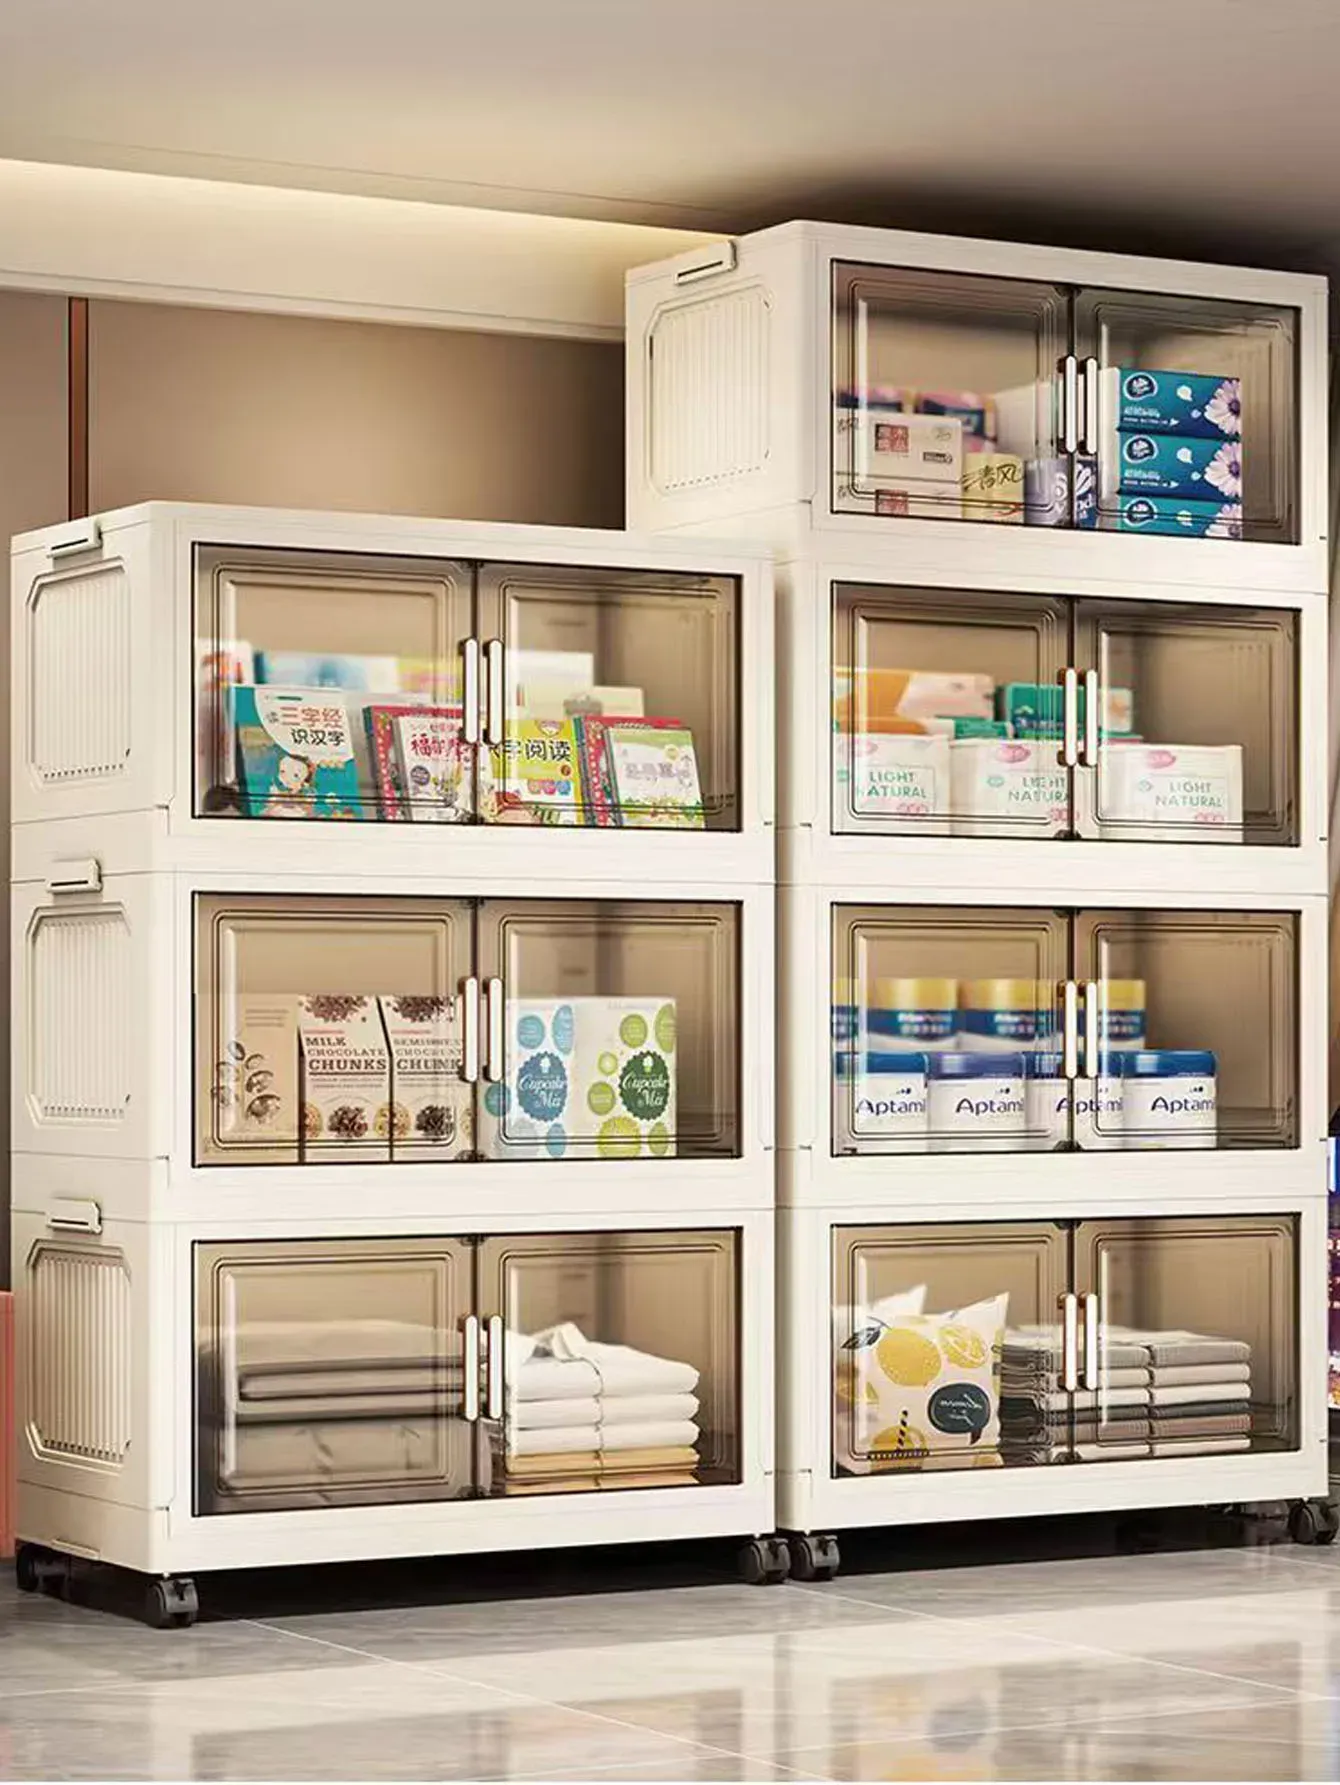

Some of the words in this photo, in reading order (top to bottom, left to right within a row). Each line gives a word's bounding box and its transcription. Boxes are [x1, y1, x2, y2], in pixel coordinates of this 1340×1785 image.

[280, 705, 343, 728] 三字经
[291, 728, 345, 747] 识汉字
[869, 771, 914, 783] LIGHT
[1170, 781, 1212, 793] LIGHT
[1008, 790, 1069, 803] NATURA
[1155, 795, 1223, 808] NATURAL
[305, 1036, 346, 1047] MILK
[307, 1047, 386, 1058] CHOCOLATE
[308, 1058, 388, 1071] CHUNKS
[396, 1058, 463, 1070] CHUNK
